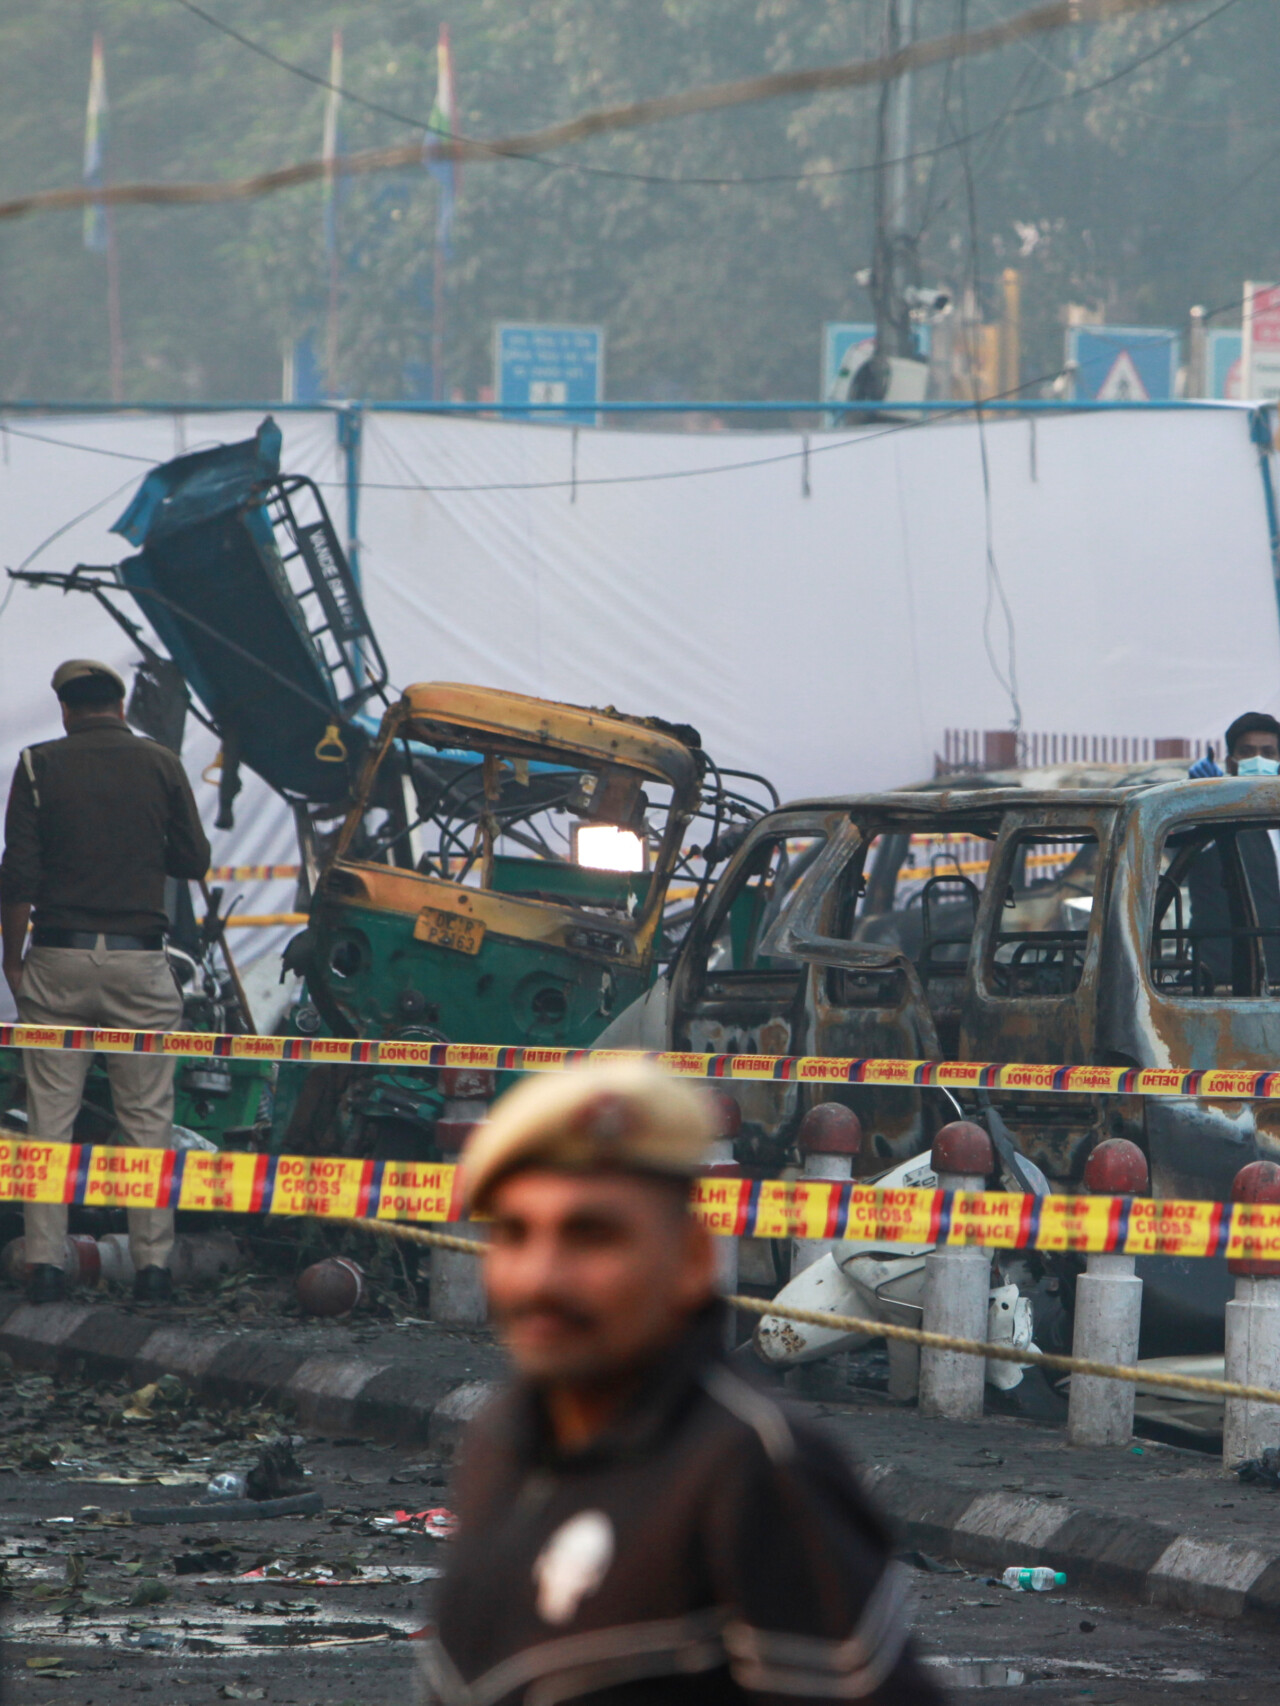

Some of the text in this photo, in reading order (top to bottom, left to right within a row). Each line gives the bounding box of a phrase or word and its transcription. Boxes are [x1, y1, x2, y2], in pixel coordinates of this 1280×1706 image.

[309, 528, 340, 579] VANDE
[163, 1036, 213, 1051] DO NOT
[380, 1047, 428, 1060] DO NOT
[801, 1064, 849, 1078] DO NOT
[1006, 1073, 1053, 1085] DO NOT
[1208, 1081, 1255, 1093] DO NOT
[16, 1147, 53, 1163] NOT
[0, 1163, 48, 1180] ROSS
[96, 1156, 150, 1174] DELHI
[278, 1160, 346, 1178] DO NOT
[88, 1180, 154, 1198] POLICE
[281, 1178, 341, 1196] CROSS
[388, 1172, 441, 1190] DELHI
[0, 1181, 38, 1199] LINE
[851, 1190, 918, 1207] DO NOT
[290, 1196, 331, 1213] LINE
[381, 1195, 447, 1213] POLICE
[959, 1199, 1009, 1217] DELHI
[1131, 1202, 1197, 1219] DO NOT
[691, 1211, 732, 1229] LICE
[855, 1206, 913, 1223] CROSS
[863, 1225, 903, 1241] LINE
[952, 1222, 1015, 1240] POLICE
[1135, 1219, 1192, 1236] CROSS
[1143, 1237, 1183, 1252] LINE
